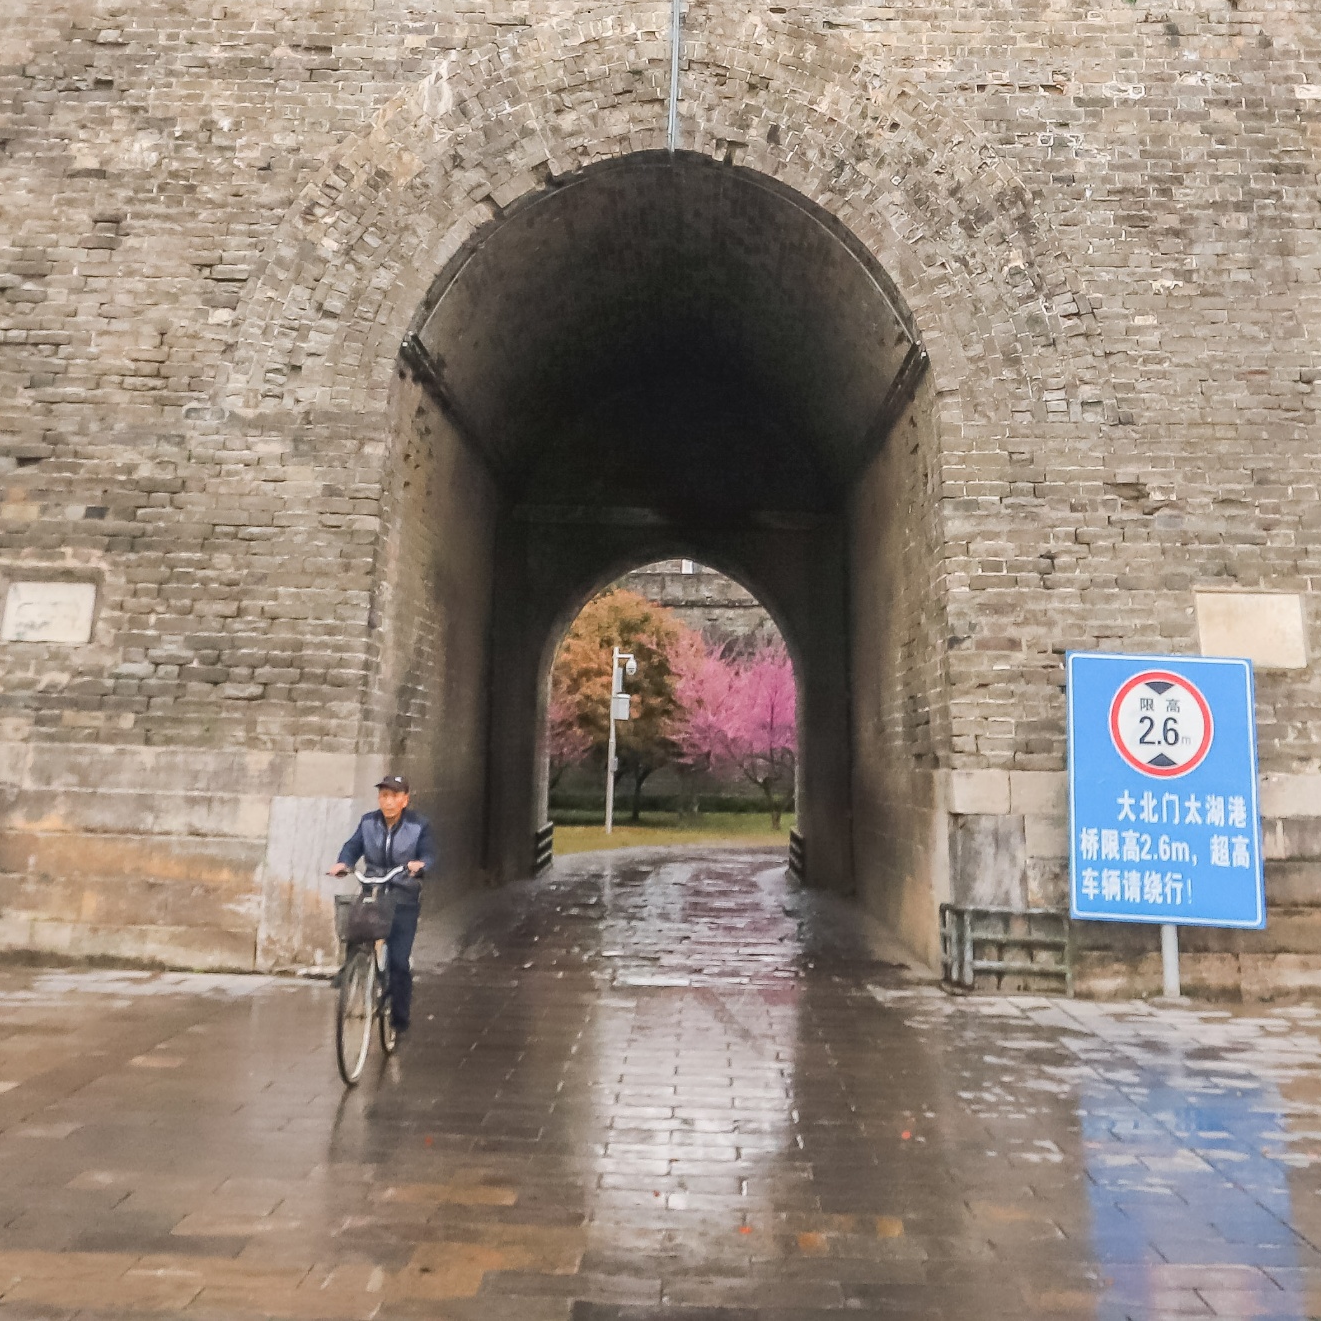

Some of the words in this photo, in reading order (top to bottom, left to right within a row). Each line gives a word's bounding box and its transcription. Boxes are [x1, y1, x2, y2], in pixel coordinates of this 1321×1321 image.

[1140, 697, 1181, 713] 限高
[1117, 790, 1247, 828] 大北门太湖港
